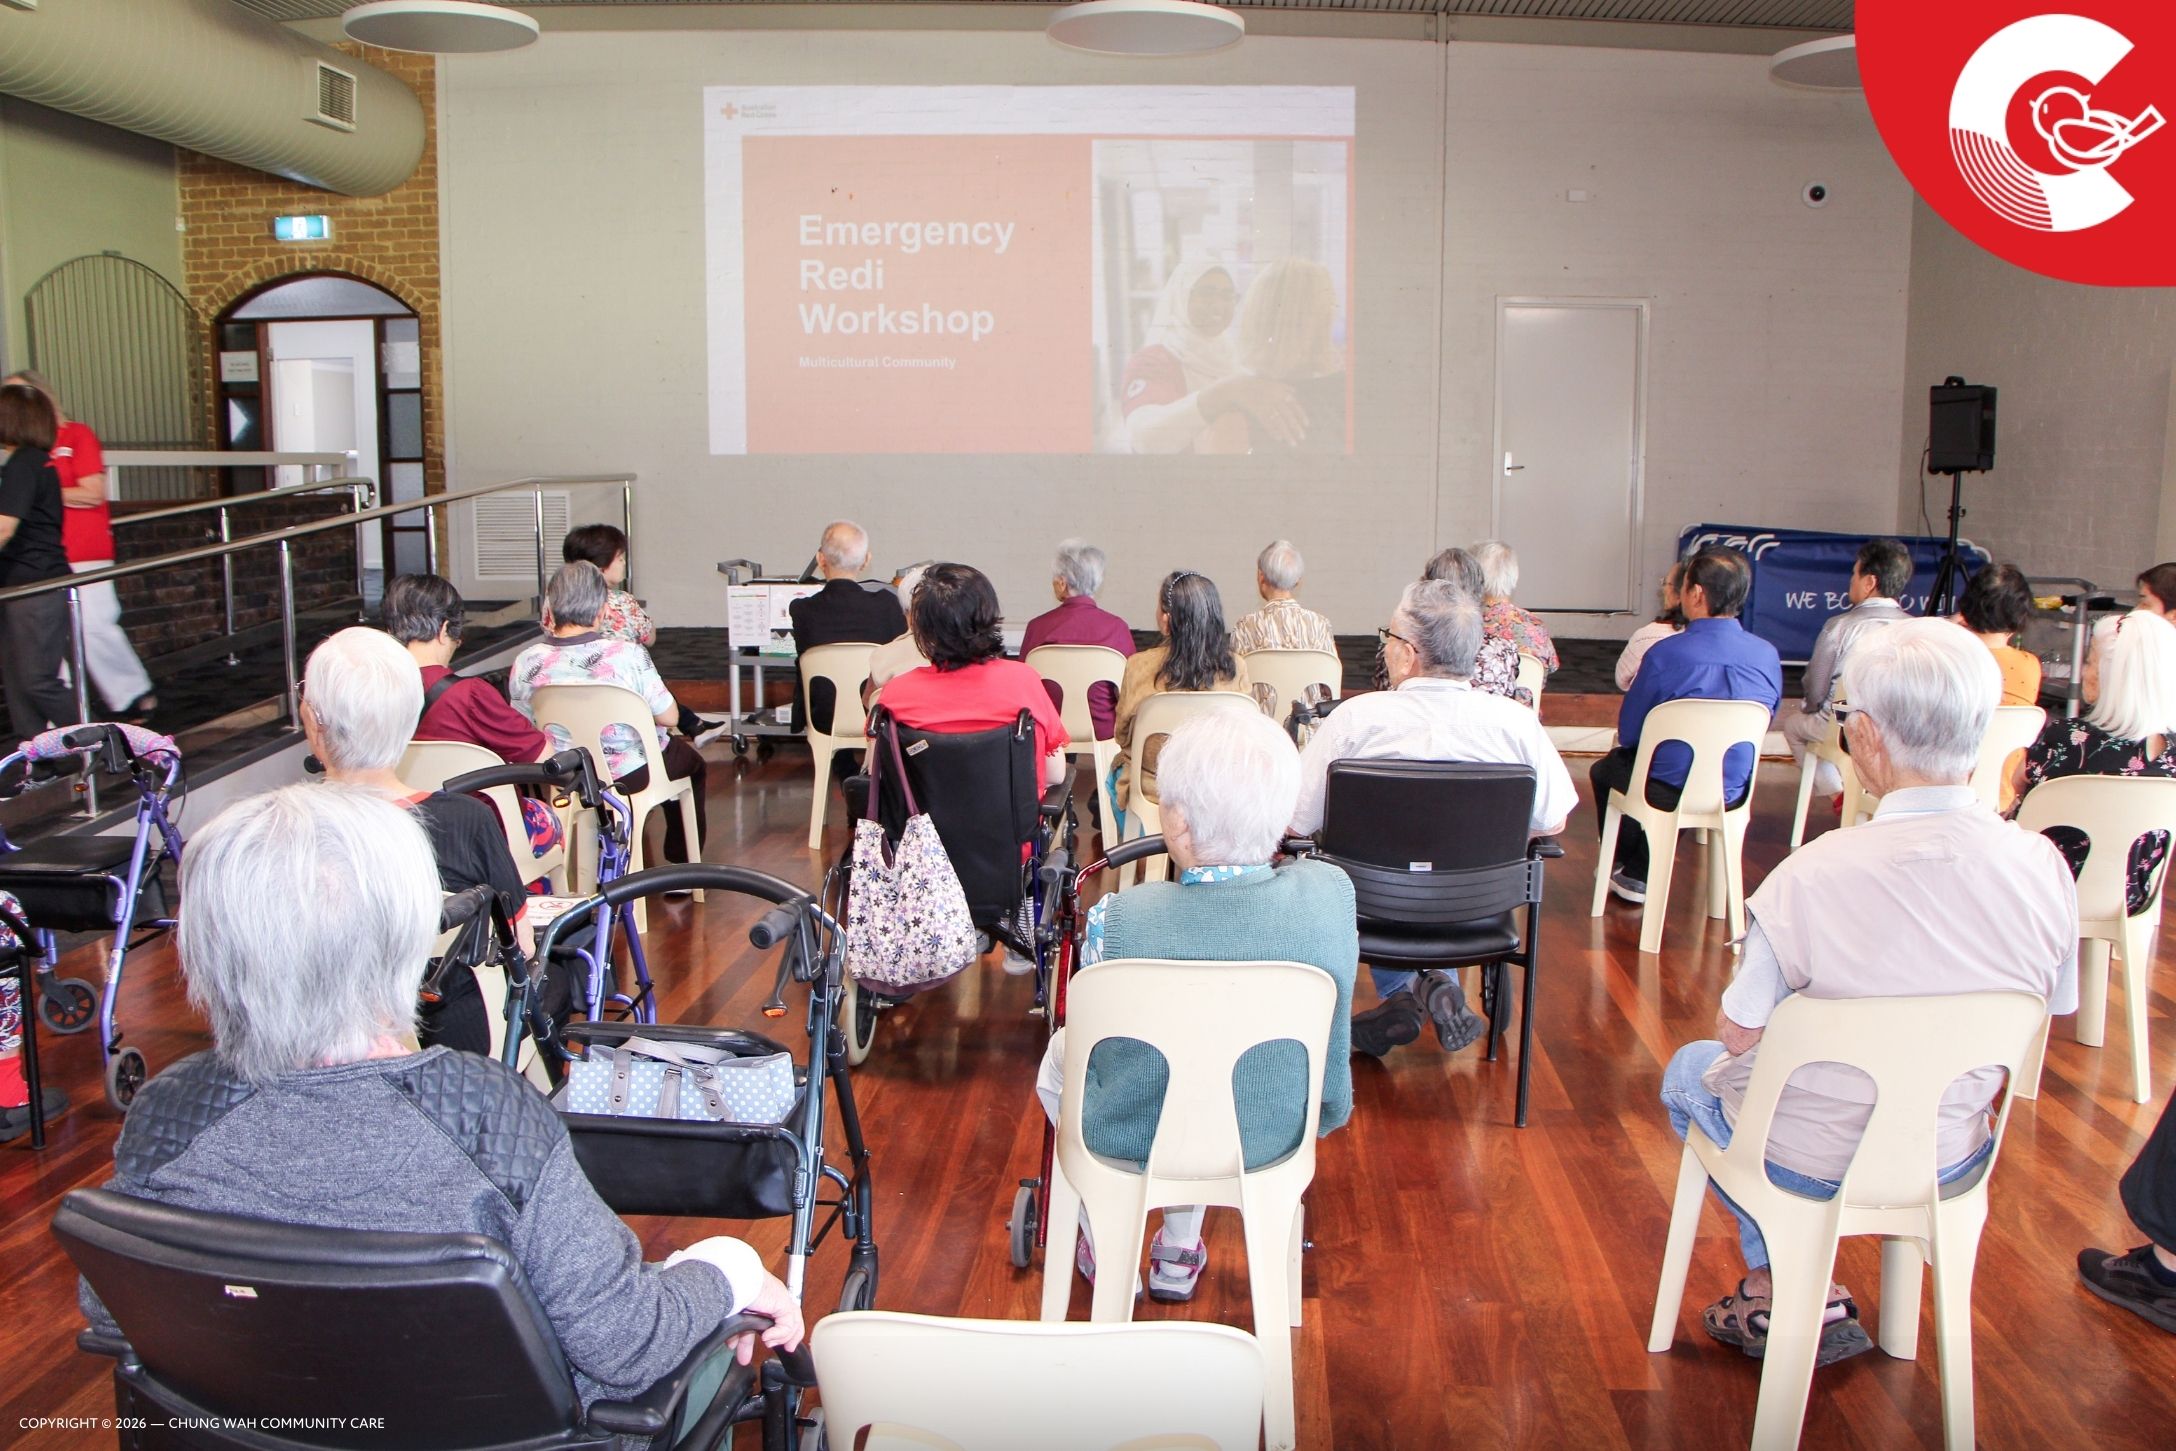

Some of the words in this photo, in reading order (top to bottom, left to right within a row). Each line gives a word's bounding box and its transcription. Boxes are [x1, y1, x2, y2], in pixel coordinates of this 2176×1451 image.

[798, 213, 1016, 255] Emergency
[798, 257, 885, 292] Redi
[798, 302, 996, 343] Workshop
[799, 355, 879, 370] Multicultural
[882, 355, 957, 372] Community
[1785, 590, 1818, 610] WE
